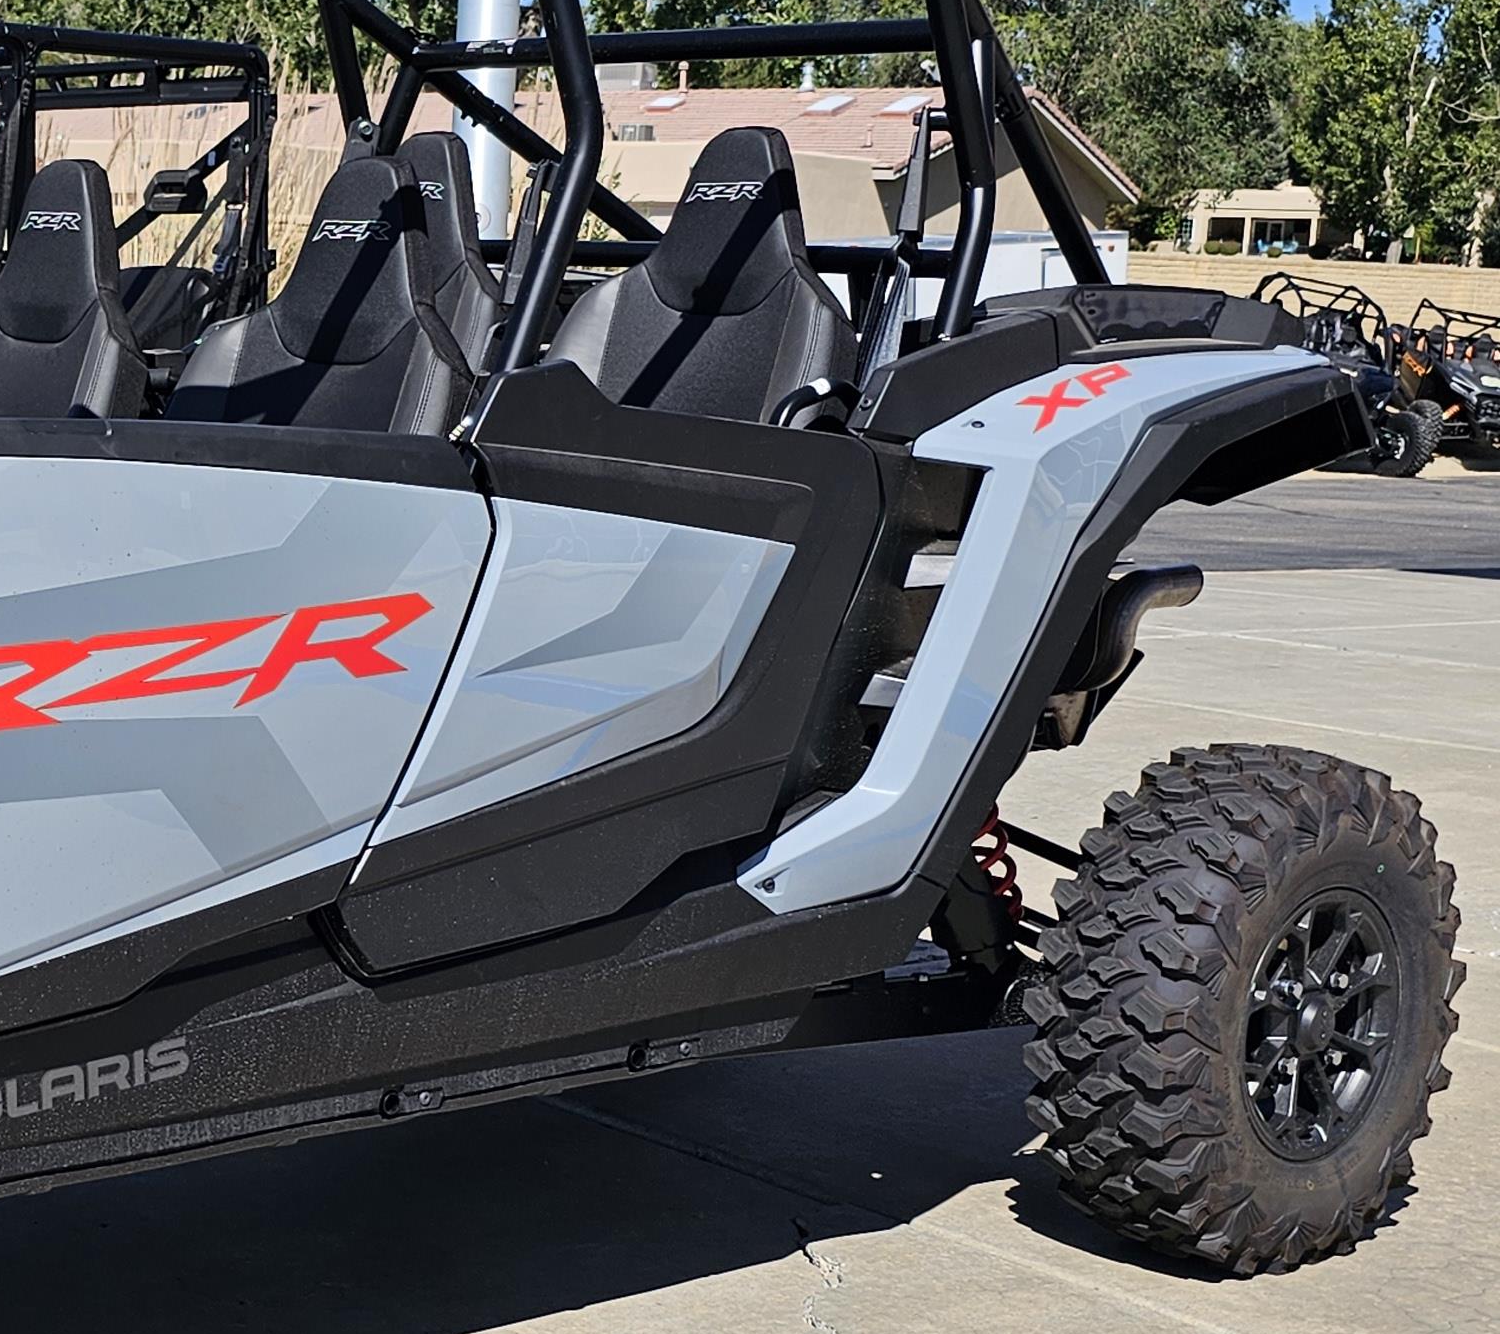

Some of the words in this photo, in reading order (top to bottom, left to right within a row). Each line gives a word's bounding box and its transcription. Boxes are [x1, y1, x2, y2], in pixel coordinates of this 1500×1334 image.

[684, 181, 764, 204] RZR
[20, 211, 82, 231] RZR
[312, 219, 392, 242] RZR
[1015, 363, 1132, 434] XP
